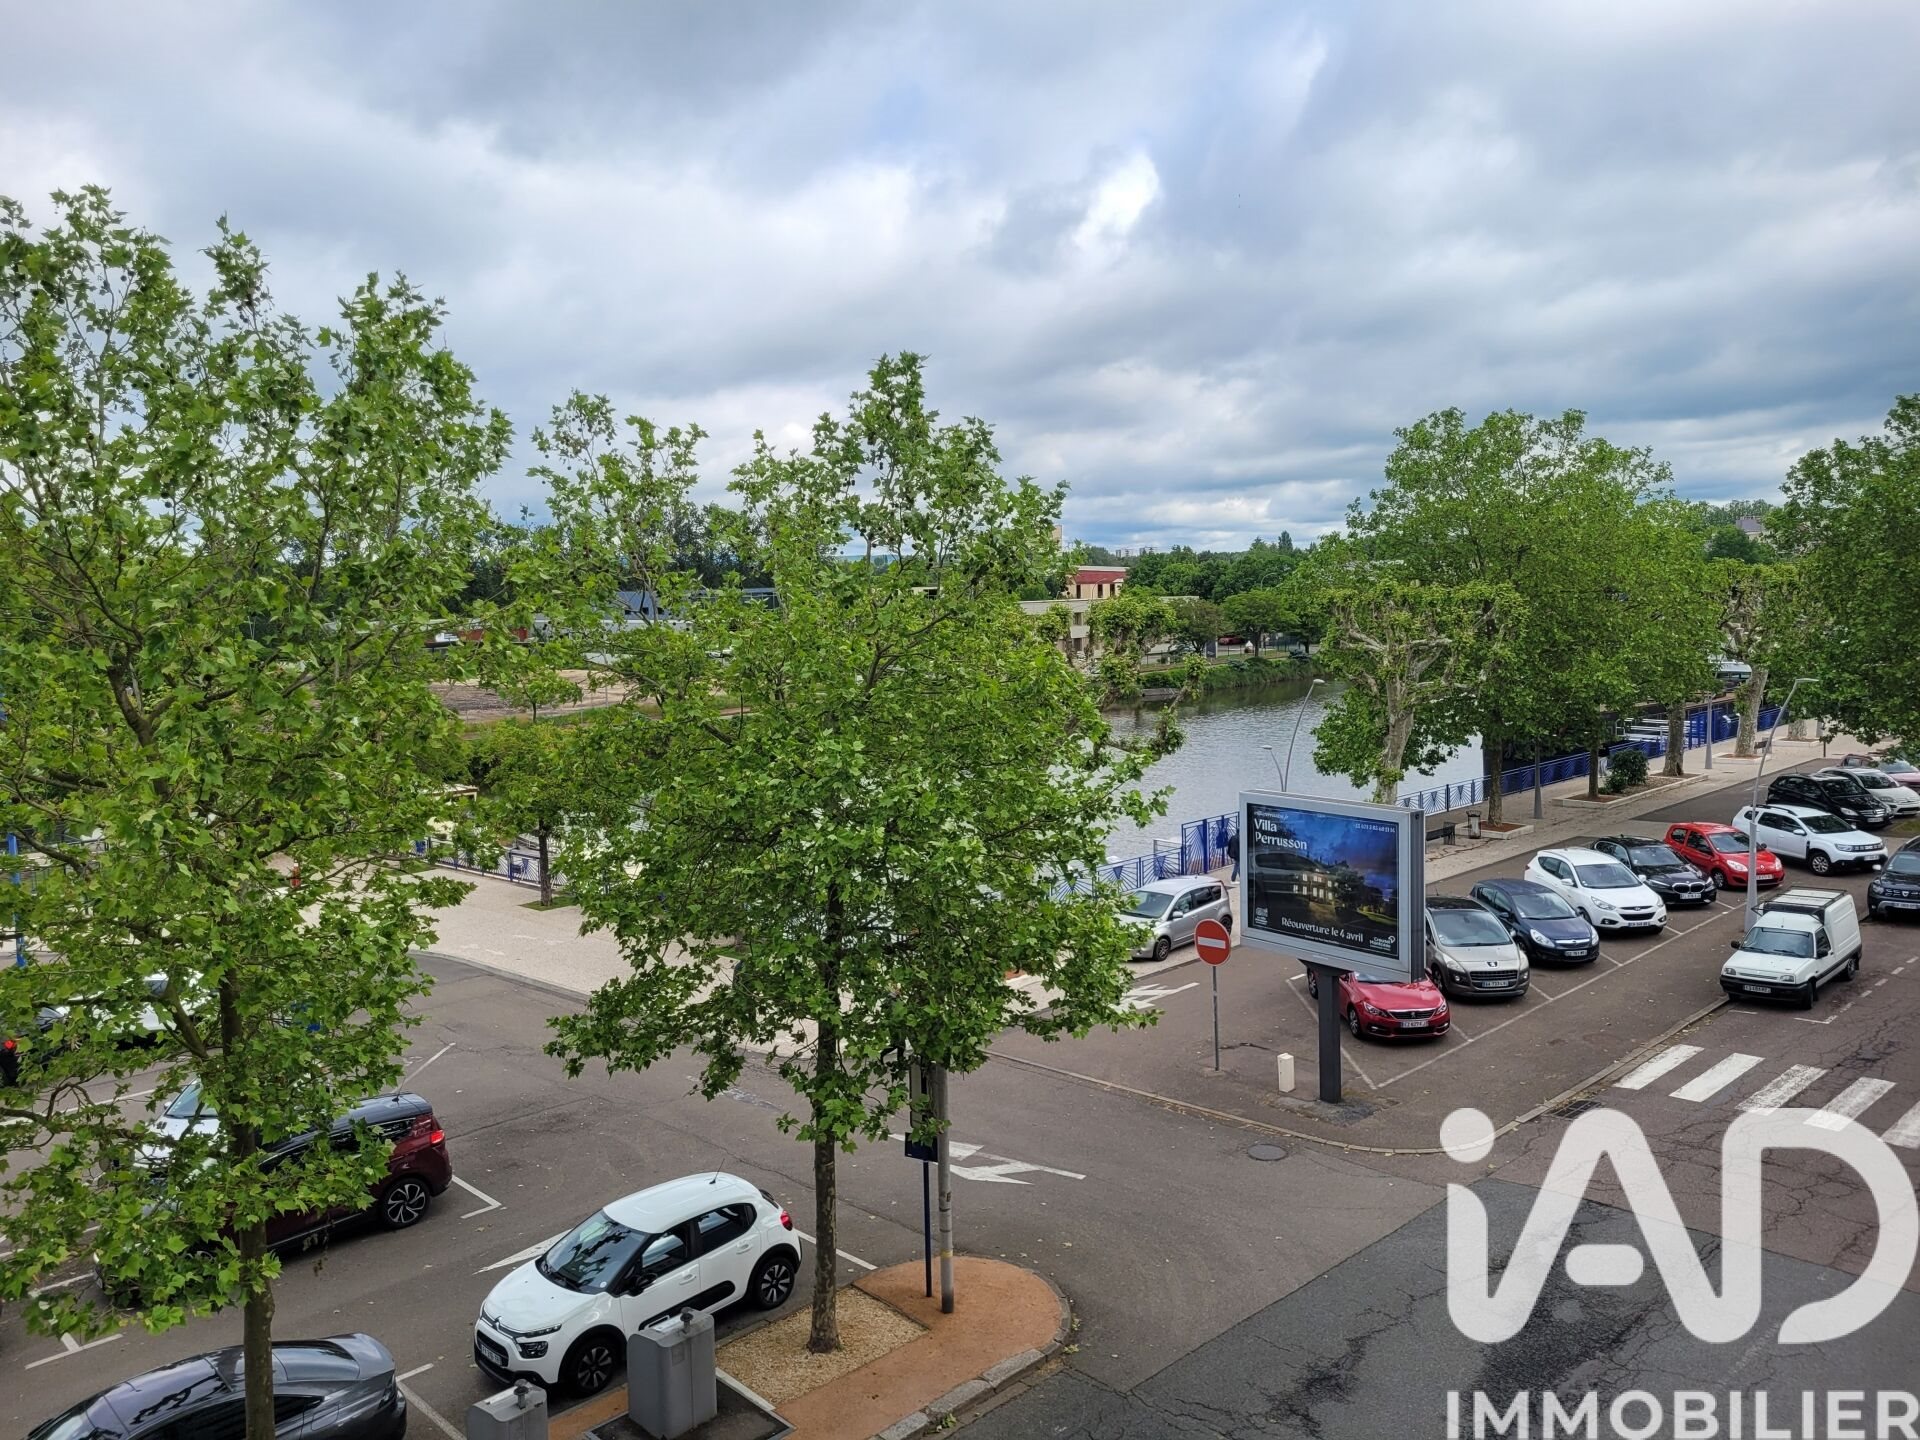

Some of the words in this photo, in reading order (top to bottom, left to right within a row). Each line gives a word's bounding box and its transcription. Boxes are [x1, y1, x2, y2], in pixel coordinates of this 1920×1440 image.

[1254, 818, 1278, 832] Villa
[1255, 831, 1308, 851] Perrusson
[1281, 916, 1330, 935] Réouverture
[1331, 926, 1339, 937] le
[1339, 928, 1345, 938] 4
[1346, 931, 1364, 943] avril
